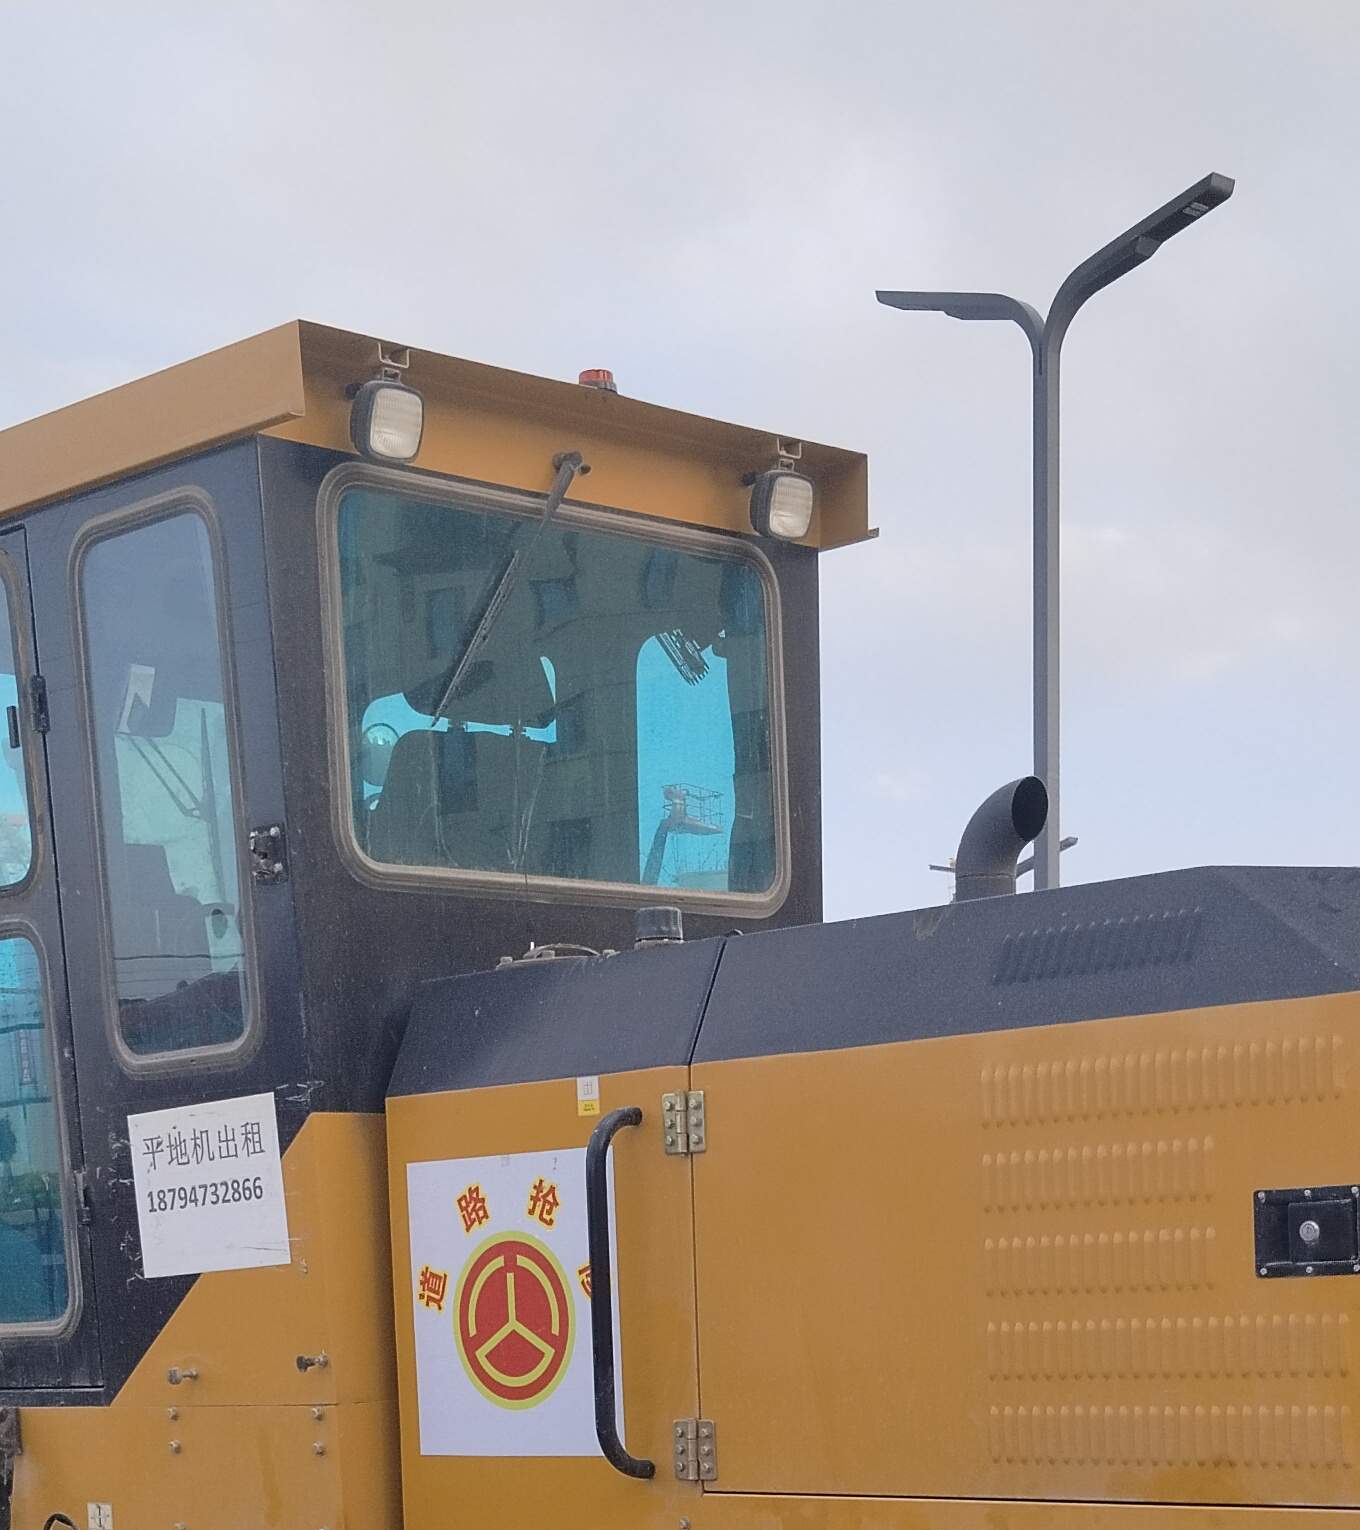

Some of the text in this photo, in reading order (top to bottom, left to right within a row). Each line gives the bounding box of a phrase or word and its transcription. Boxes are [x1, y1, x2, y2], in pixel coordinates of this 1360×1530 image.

[142, 1121, 266, 1170] 平地机出租
[147, 1177, 264, 1212] 18794732866
